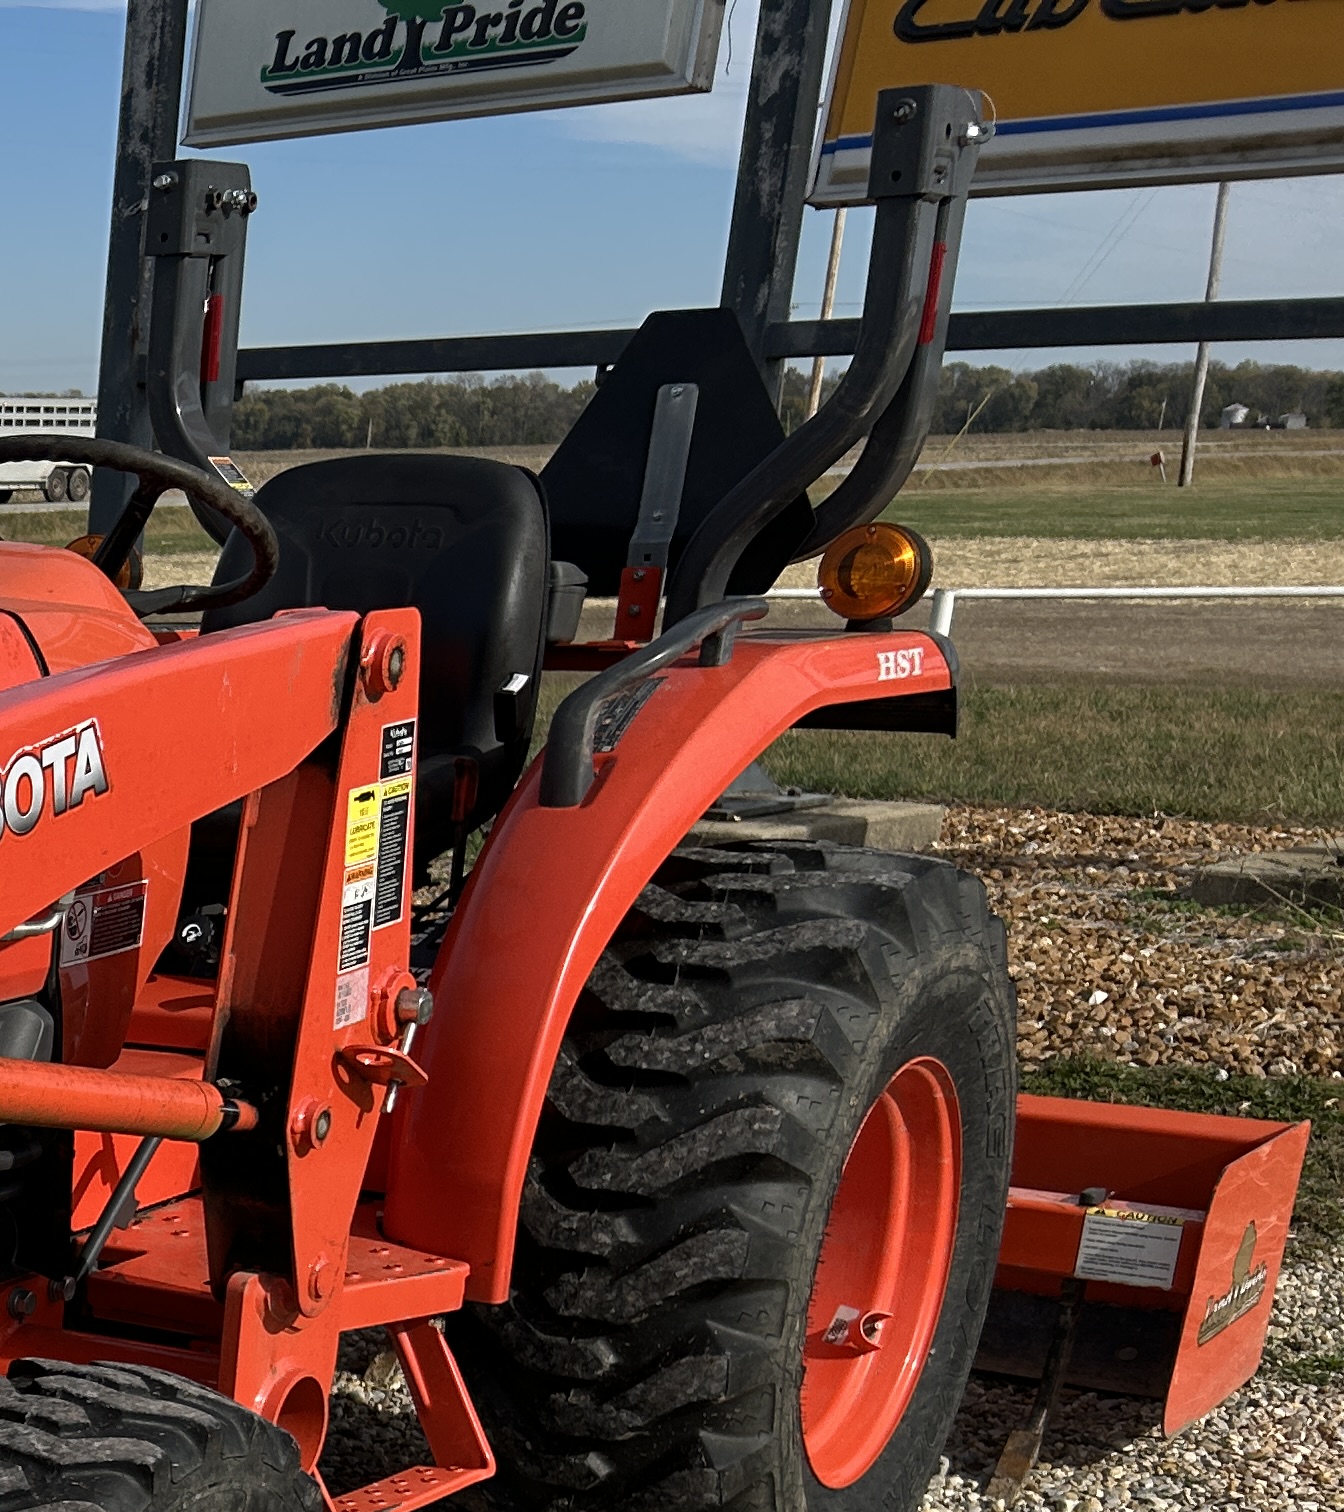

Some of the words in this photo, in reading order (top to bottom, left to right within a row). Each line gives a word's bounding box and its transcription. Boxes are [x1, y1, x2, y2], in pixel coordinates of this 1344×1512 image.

[267, 14, 400, 74] Land
[433, 0, 586, 52] Pride
[314, 515, 446, 550] Kubota
[876, 646, 925, 682] HST
